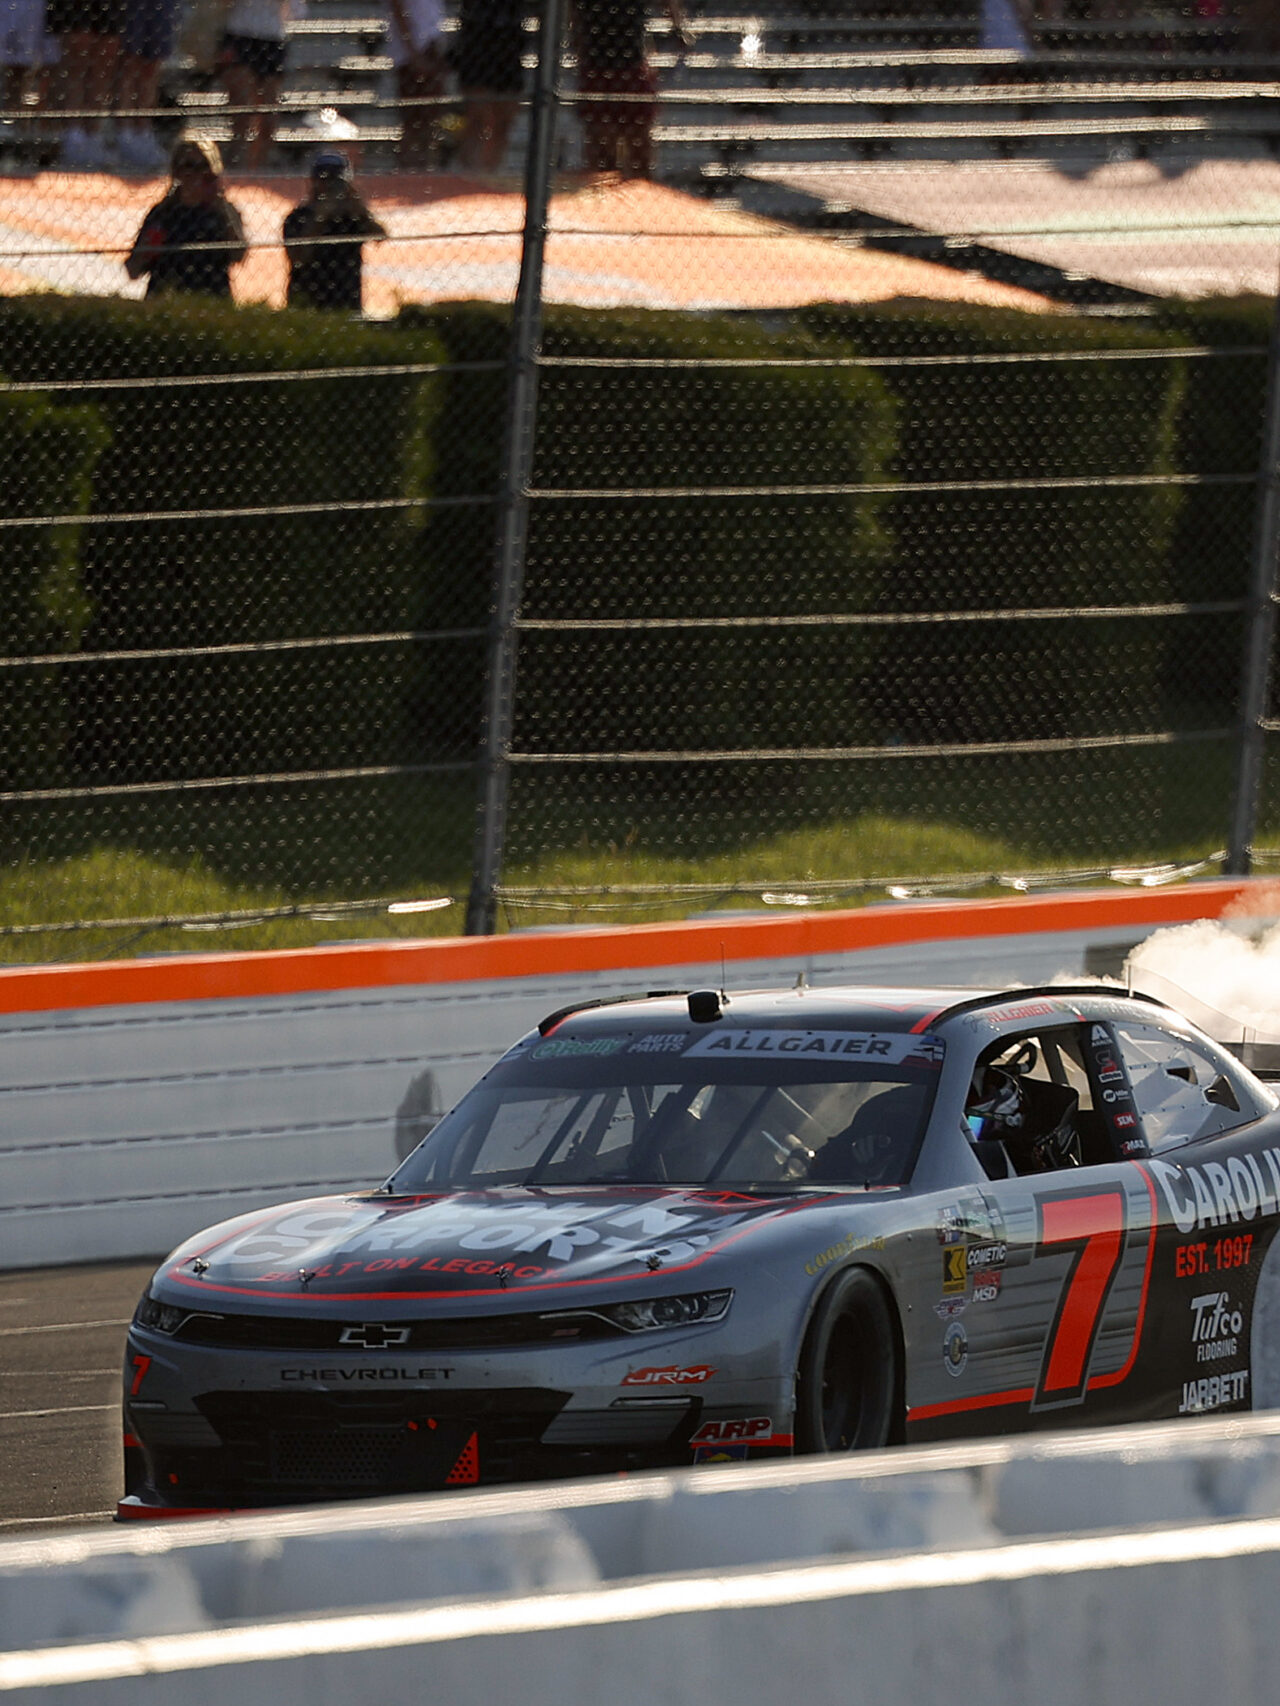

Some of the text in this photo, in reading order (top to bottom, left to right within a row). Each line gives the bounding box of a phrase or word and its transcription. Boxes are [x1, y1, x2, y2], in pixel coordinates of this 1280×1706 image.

[627, 1041, 684, 1053] PARTS
[639, 1034, 687, 1043] AUTO
[707, 1035, 893, 1056] ALLGAIER
[363, 1257, 417, 1274] ON
[967, 1245, 1007, 1266] COMETIC
[1175, 1235, 1253, 1278] EST. 1997
[972, 1286, 997, 1302] MSD
[1037, 1186, 1125, 1400] 7
[1197, 1337, 1237, 1363] FLOORING
[131, 1356, 151, 1396] 7
[279, 1367, 456, 1382] CHEVROLET
[626, 1369, 707, 1384] JRM
[1179, 1370, 1249, 1413] JARRETT
[695, 1418, 771, 1439] ARP
